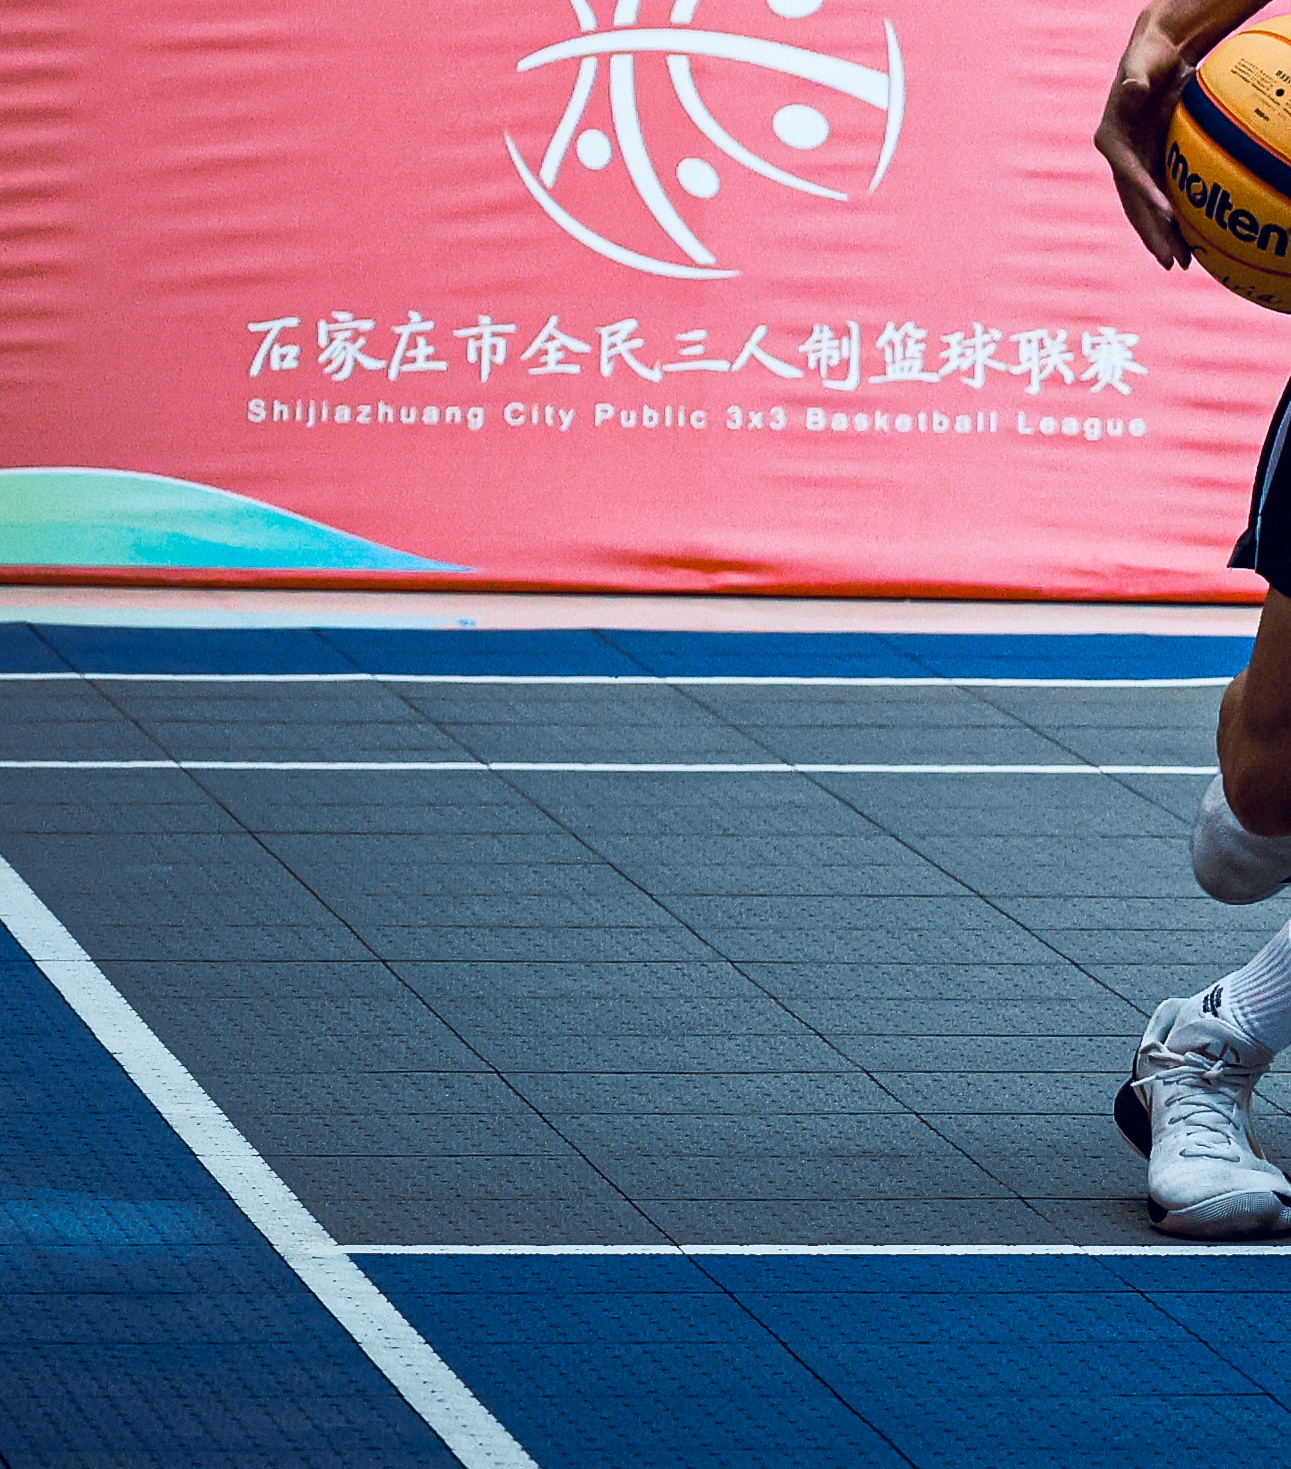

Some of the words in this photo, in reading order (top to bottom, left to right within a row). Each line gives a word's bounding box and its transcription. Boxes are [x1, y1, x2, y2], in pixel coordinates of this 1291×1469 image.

[1167, 142, 1290, 257] molten
[247, 398, 485, 430] Shijiazhuang
[504, 401, 575, 431] City
[595, 402, 707, 430] Public
[725, 405, 787, 431] 3x3
[805, 407, 998, 434] Basketball
[1017, 410, 1147, 441] League
